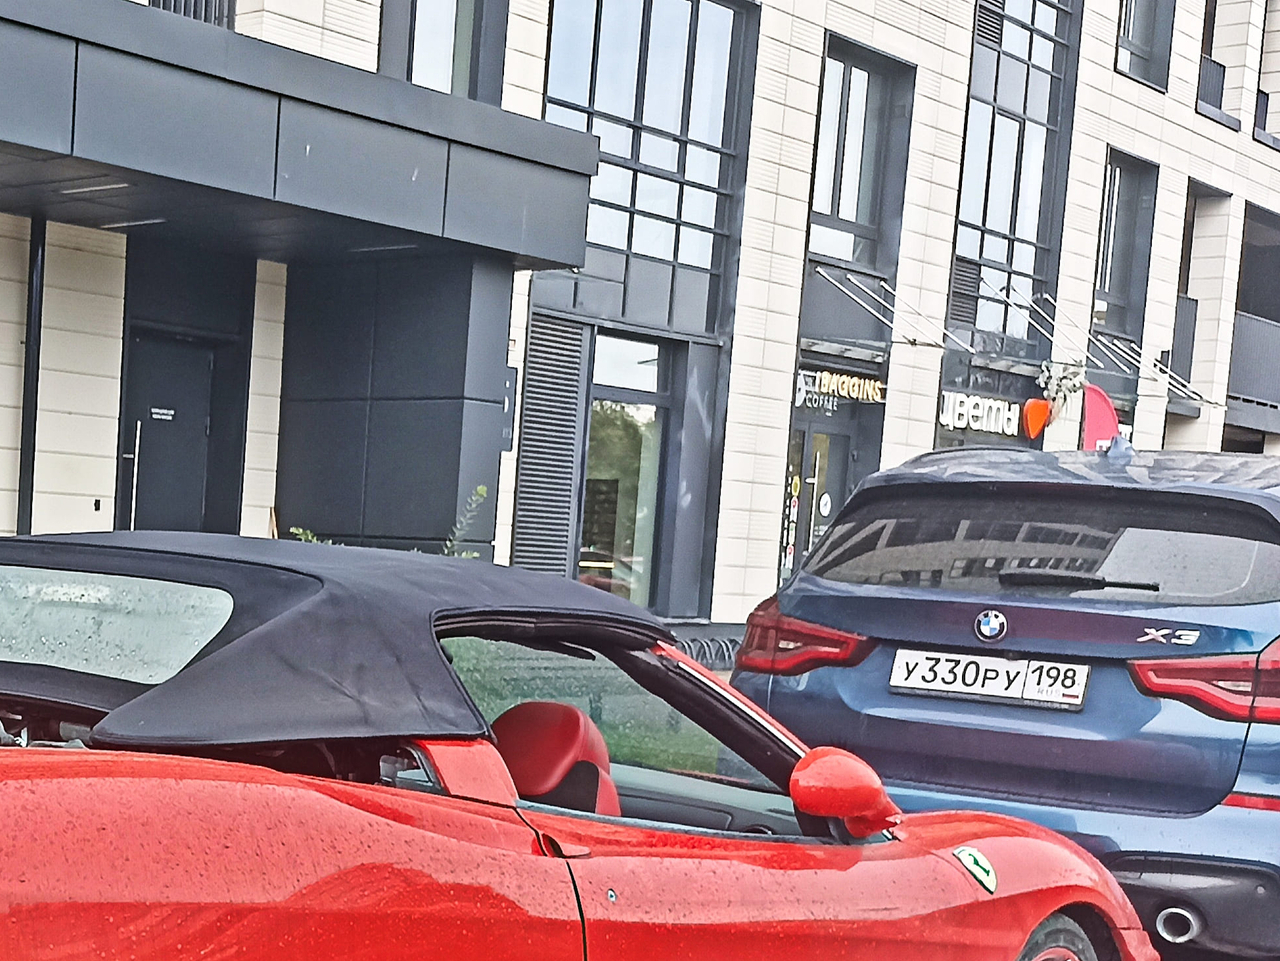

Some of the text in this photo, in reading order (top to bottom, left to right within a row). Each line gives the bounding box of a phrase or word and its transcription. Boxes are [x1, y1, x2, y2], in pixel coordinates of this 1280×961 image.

[820, 370, 882, 402] BAGGINS
[806, 393, 839, 411] COFFEE
[1136, 627, 1200, 645] X3
[1031, 665, 1077, 689] 198
